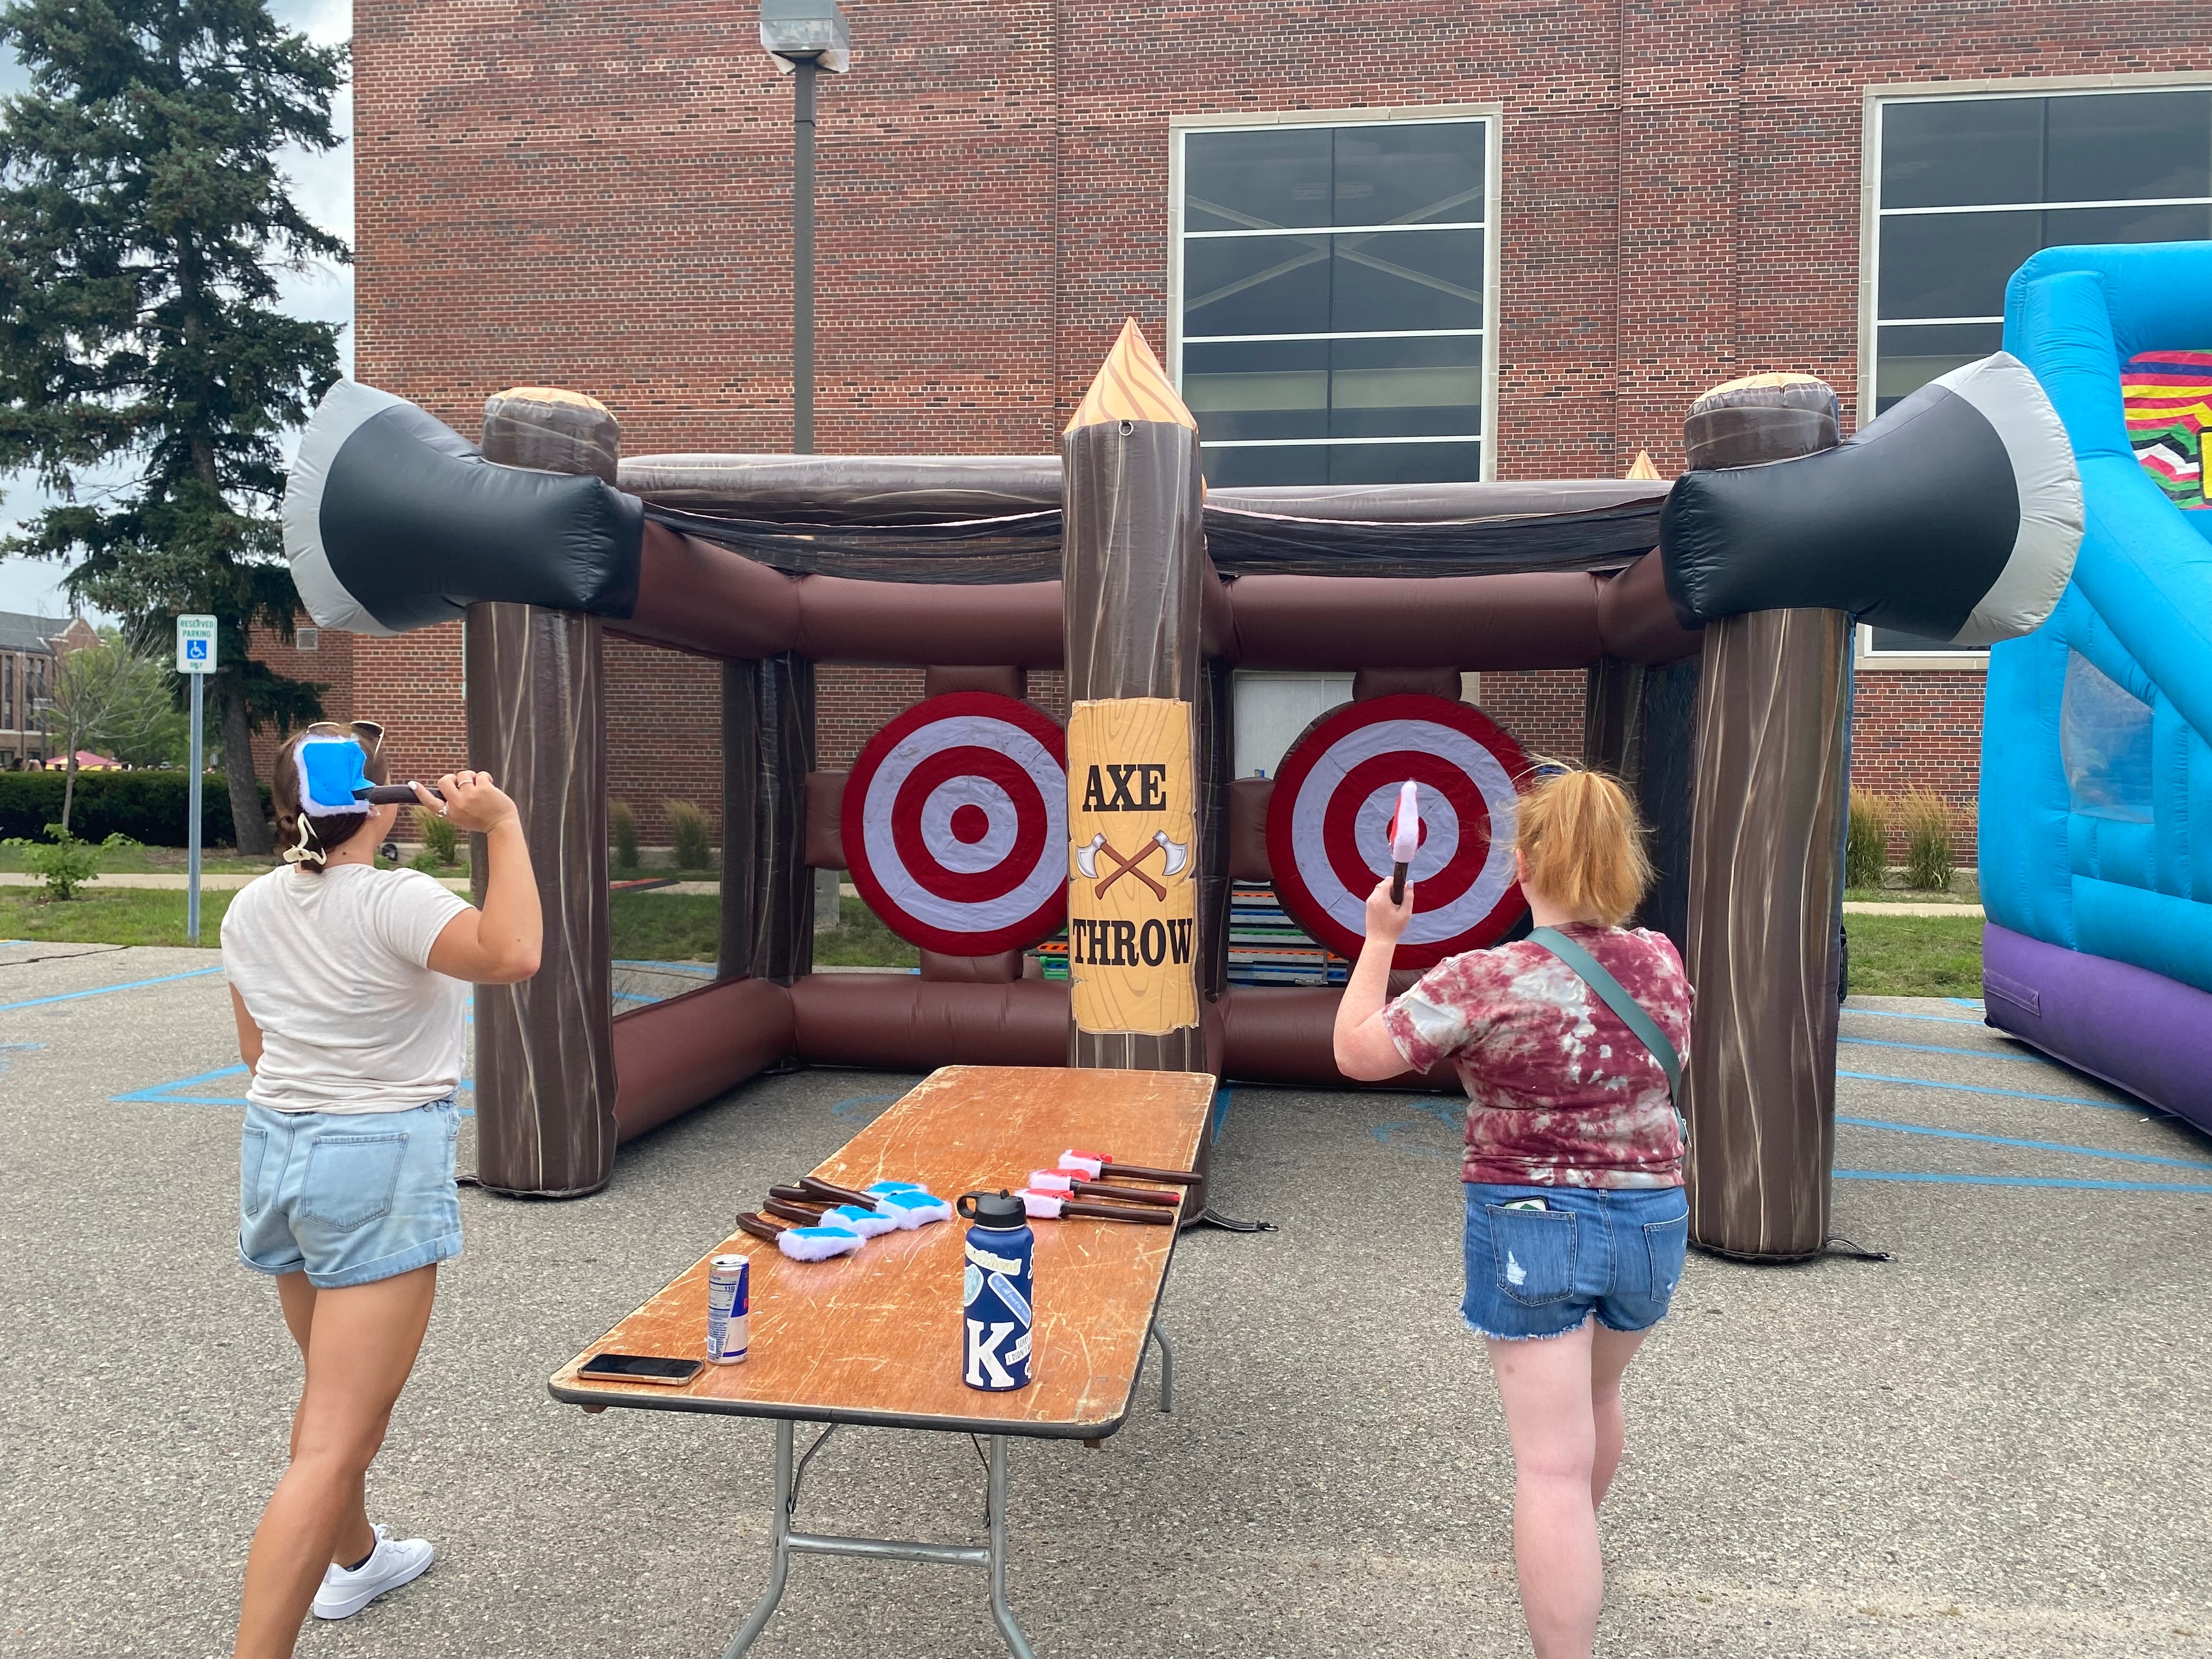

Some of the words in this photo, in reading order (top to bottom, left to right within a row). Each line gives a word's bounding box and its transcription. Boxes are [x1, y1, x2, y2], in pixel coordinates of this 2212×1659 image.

[180, 620, 214, 628] RESERVED
[1082, 764, 1166, 812] AXE
[1073, 918, 1193, 967] THROW
[965, 1318, 1015, 1388] K
